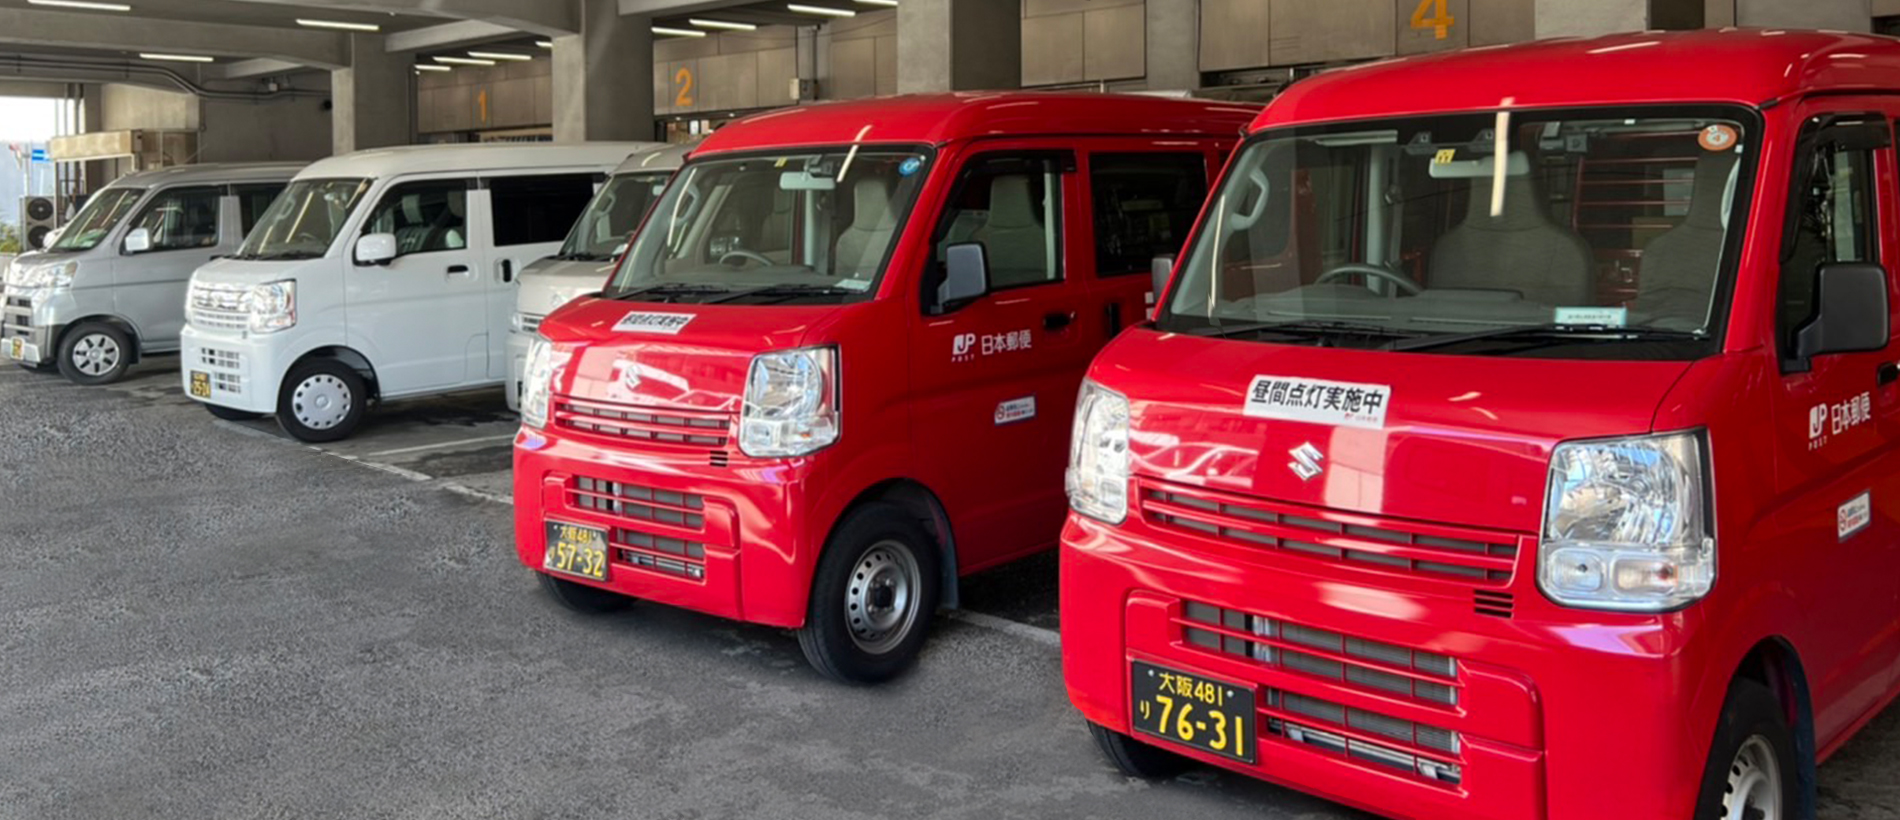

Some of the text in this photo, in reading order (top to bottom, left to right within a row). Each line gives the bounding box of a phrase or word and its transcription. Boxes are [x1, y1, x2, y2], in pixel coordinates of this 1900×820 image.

[1410, 0, 1455, 40] 4
[675, 67, 693, 106] 2
[478, 89, 488, 122] 1
[981, 329, 1032, 356] 日本郵便
[1251, 379, 1383, 414] 昼間点灯実施中
[1831, 391, 1871, 435] 日本郵便
[557, 541, 604, 577] 57-32
[1156, 694, 1243, 756] 76-31
